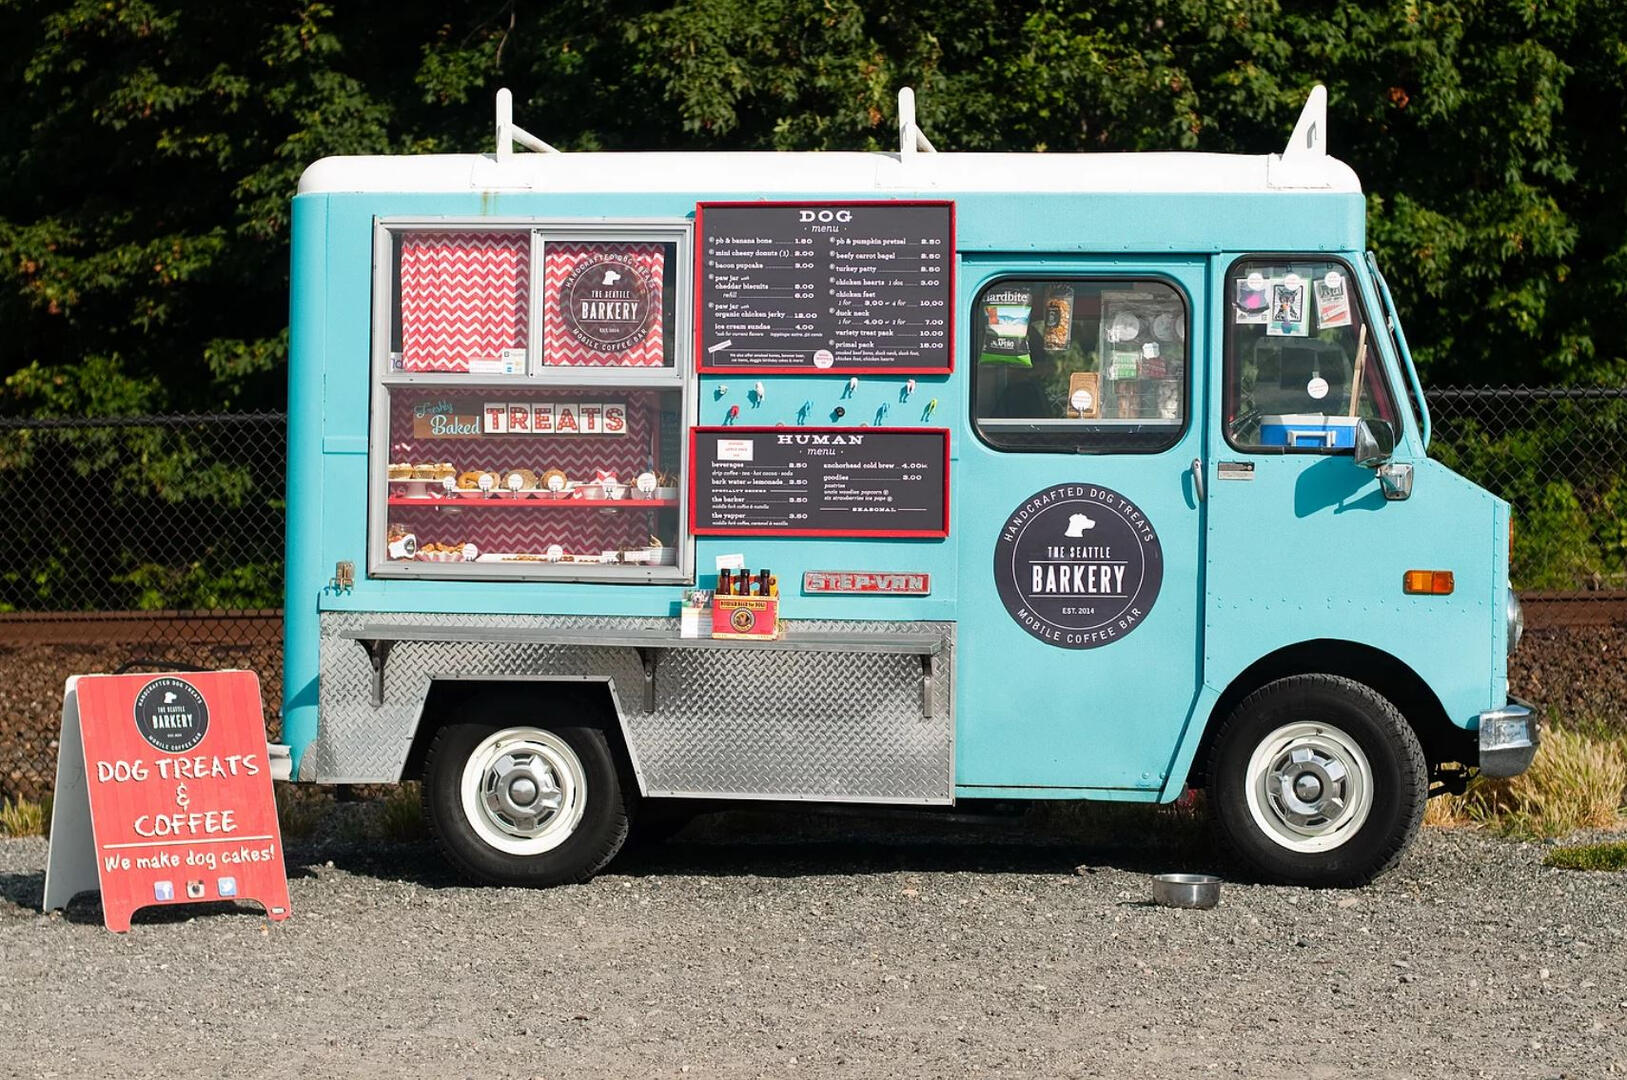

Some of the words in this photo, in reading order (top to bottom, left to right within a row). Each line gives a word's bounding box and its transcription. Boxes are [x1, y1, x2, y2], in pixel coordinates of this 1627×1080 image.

[800, 210, 853, 223] DOG
[811, 225, 839, 233] menu
[852, 238, 882, 246] pumpkin
[883, 237, 906, 246] pretzel
[732, 249, 754, 257] cheesy
[836, 252, 854, 260] beefy
[877, 252, 896, 260] bagel
[736, 262, 764, 270] pupcake
[836, 265, 858, 273] turkey
[858, 265, 877, 273] patty
[729, 274, 739, 282] jar
[835, 278, 861, 286] chicken
[863, 278, 885, 286] hearts
[714, 282, 742, 290] cheddar
[743, 282, 769, 290] biscuits
[592, 290, 602, 298] THE
[605, 290, 631, 299] SEATTLE
[722, 291, 738, 299] refill
[835, 290, 862, 298] chicken
[863, 290, 876, 298] feet
[581, 302, 639, 320] BARKERY
[714, 311, 740, 319] organic
[741, 310, 767, 318] chicken
[768, 310, 786, 319] jerky
[835, 309, 852, 317] duck
[853, 309, 870, 317] neck
[835, 329, 859, 337] variety
[877, 329, 894, 337] pack
[572, 327, 599, 350] MOBILE
[602, 340, 631, 351] COFFEE
[633, 328, 648, 343] BAR
[835, 341, 858, 349] primal
[858, 341, 875, 349] pack
[430, 414, 481, 436] Baked
[485, 406, 626, 432] TREATS
[777, 435, 864, 445] HUMAN
[807, 447, 836, 456] menu
[711, 461, 744, 469] beverages
[823, 461, 861, 469] anchorhead
[863, 461, 877, 469] cold
[878, 461, 895, 469] brew
[823, 473, 849, 481] goodies
[723, 495, 745, 503] barker
[711, 511, 723, 519] the
[723, 512, 746, 520] yapper
[1003, 486, 1084, 543] HANDCRAFTED
[1089, 487, 1114, 504] DOG
[1117, 499, 1155, 543] TREATS
[1047, 546, 1065, 559] THE
[1069, 546, 1111, 559] SEATTLE
[1032, 565, 1126, 594] BARKERY
[1062, 607, 1077, 615] EST.
[1078, 607, 1095, 615] 2014
[1016, 607, 1062, 642] MOBILE
[1066, 625, 1116, 644] COFFEE
[1118, 606, 1142, 630] BAR
[152, 713, 193, 729] BARKERY
[96, 758, 150, 784] DOG
[154, 753, 261, 781] TREATS
[175, 781, 191, 812] &
[134, 809, 239, 838] COFFEE
[103, 854, 132, 873] We
[136, 851, 180, 870] make
[185, 849, 217, 870] dog
[221, 844, 276, 864] cakes!
